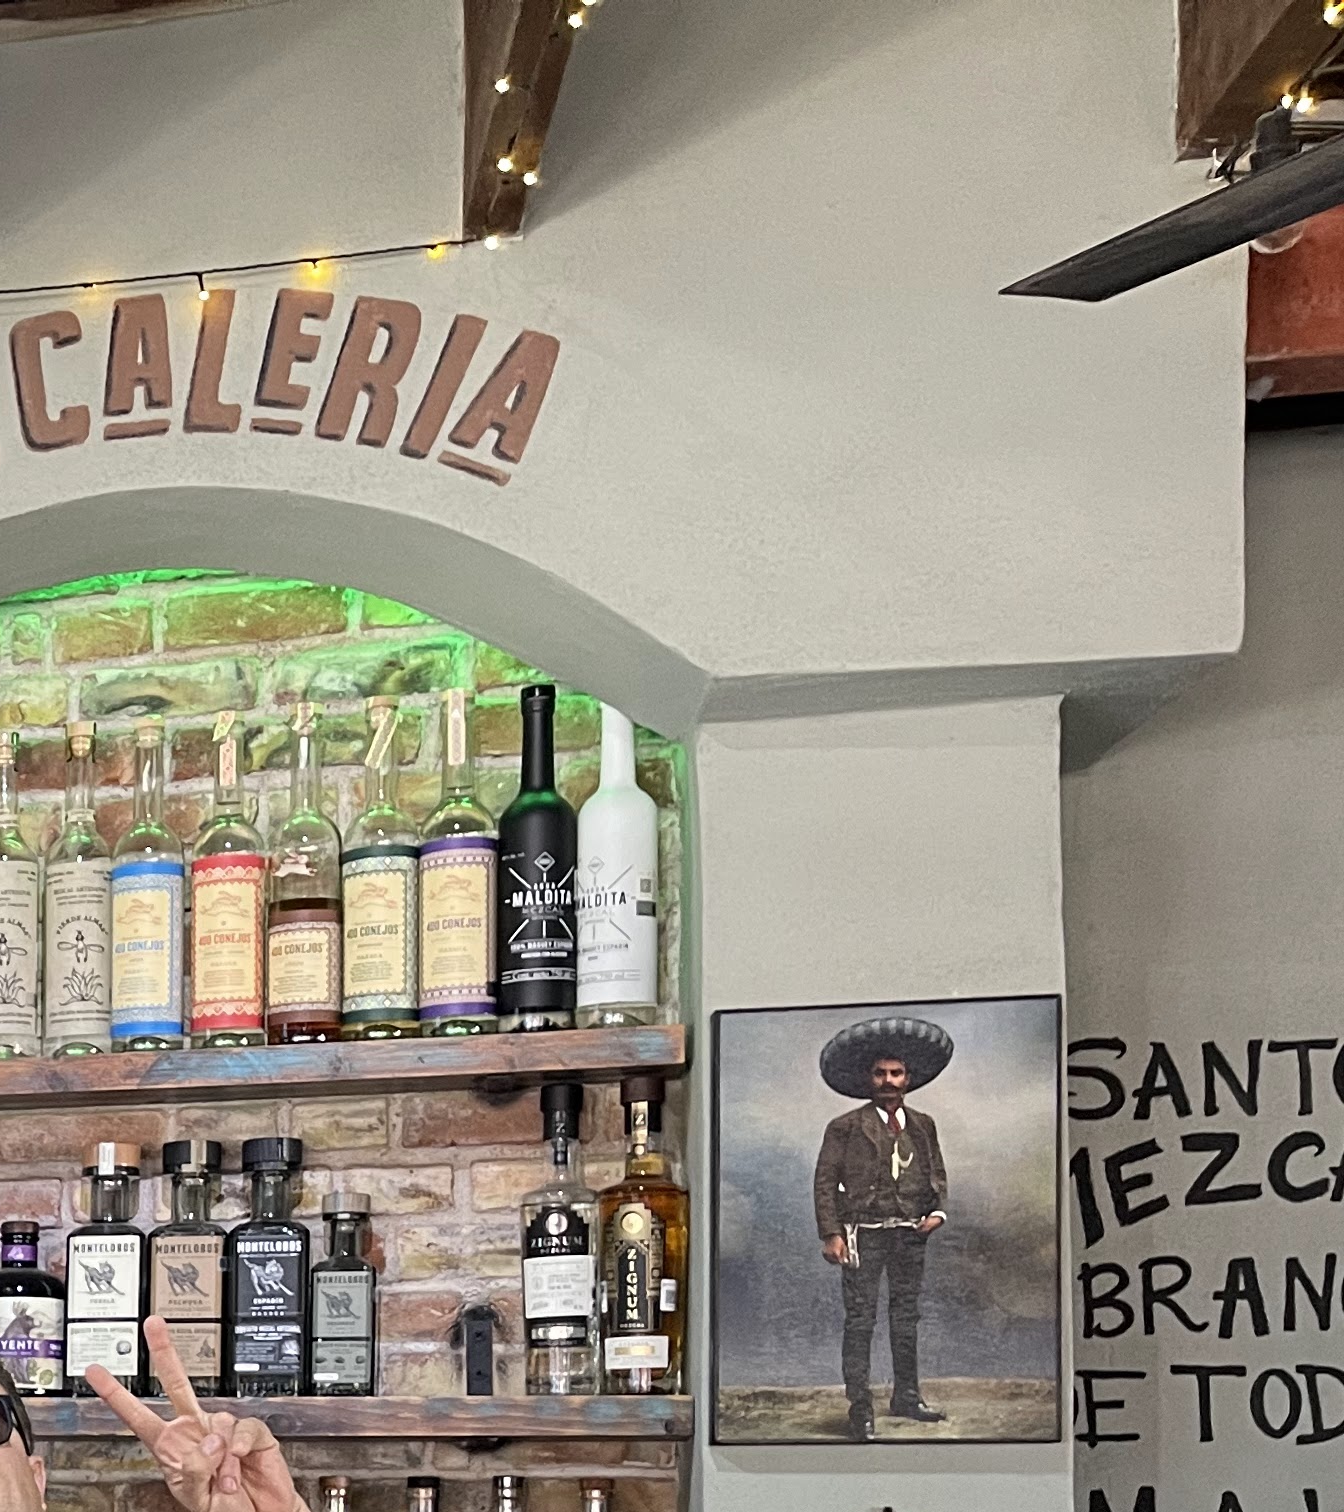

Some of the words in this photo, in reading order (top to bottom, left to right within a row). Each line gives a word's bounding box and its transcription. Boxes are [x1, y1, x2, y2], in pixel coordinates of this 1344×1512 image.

[512, 889, 572, 908] MALDITA
[359, 923, 399, 937] CONEJOS
[442, 917, 482, 930] CONEJOS
[213, 933, 251, 945] CONEJOS
[127, 940, 165, 953] CONEJOS
[284, 942, 323, 956] CONEJOS
[73, 1243, 136, 1254] MONTELOBOS
[155, 1243, 219, 1254] MONTELOBOS
[237, 1240, 302, 1253] MONTELOBOS
[530, 1235, 584, 1249] ZIGNUM
[316, 1274, 370, 1285] MONTELOBOS
[626, 1248, 641, 1322] ZIGNUM
[1077, 1253, 1344, 1340] BRAN
[1074, 1369, 1147, 1448] E
